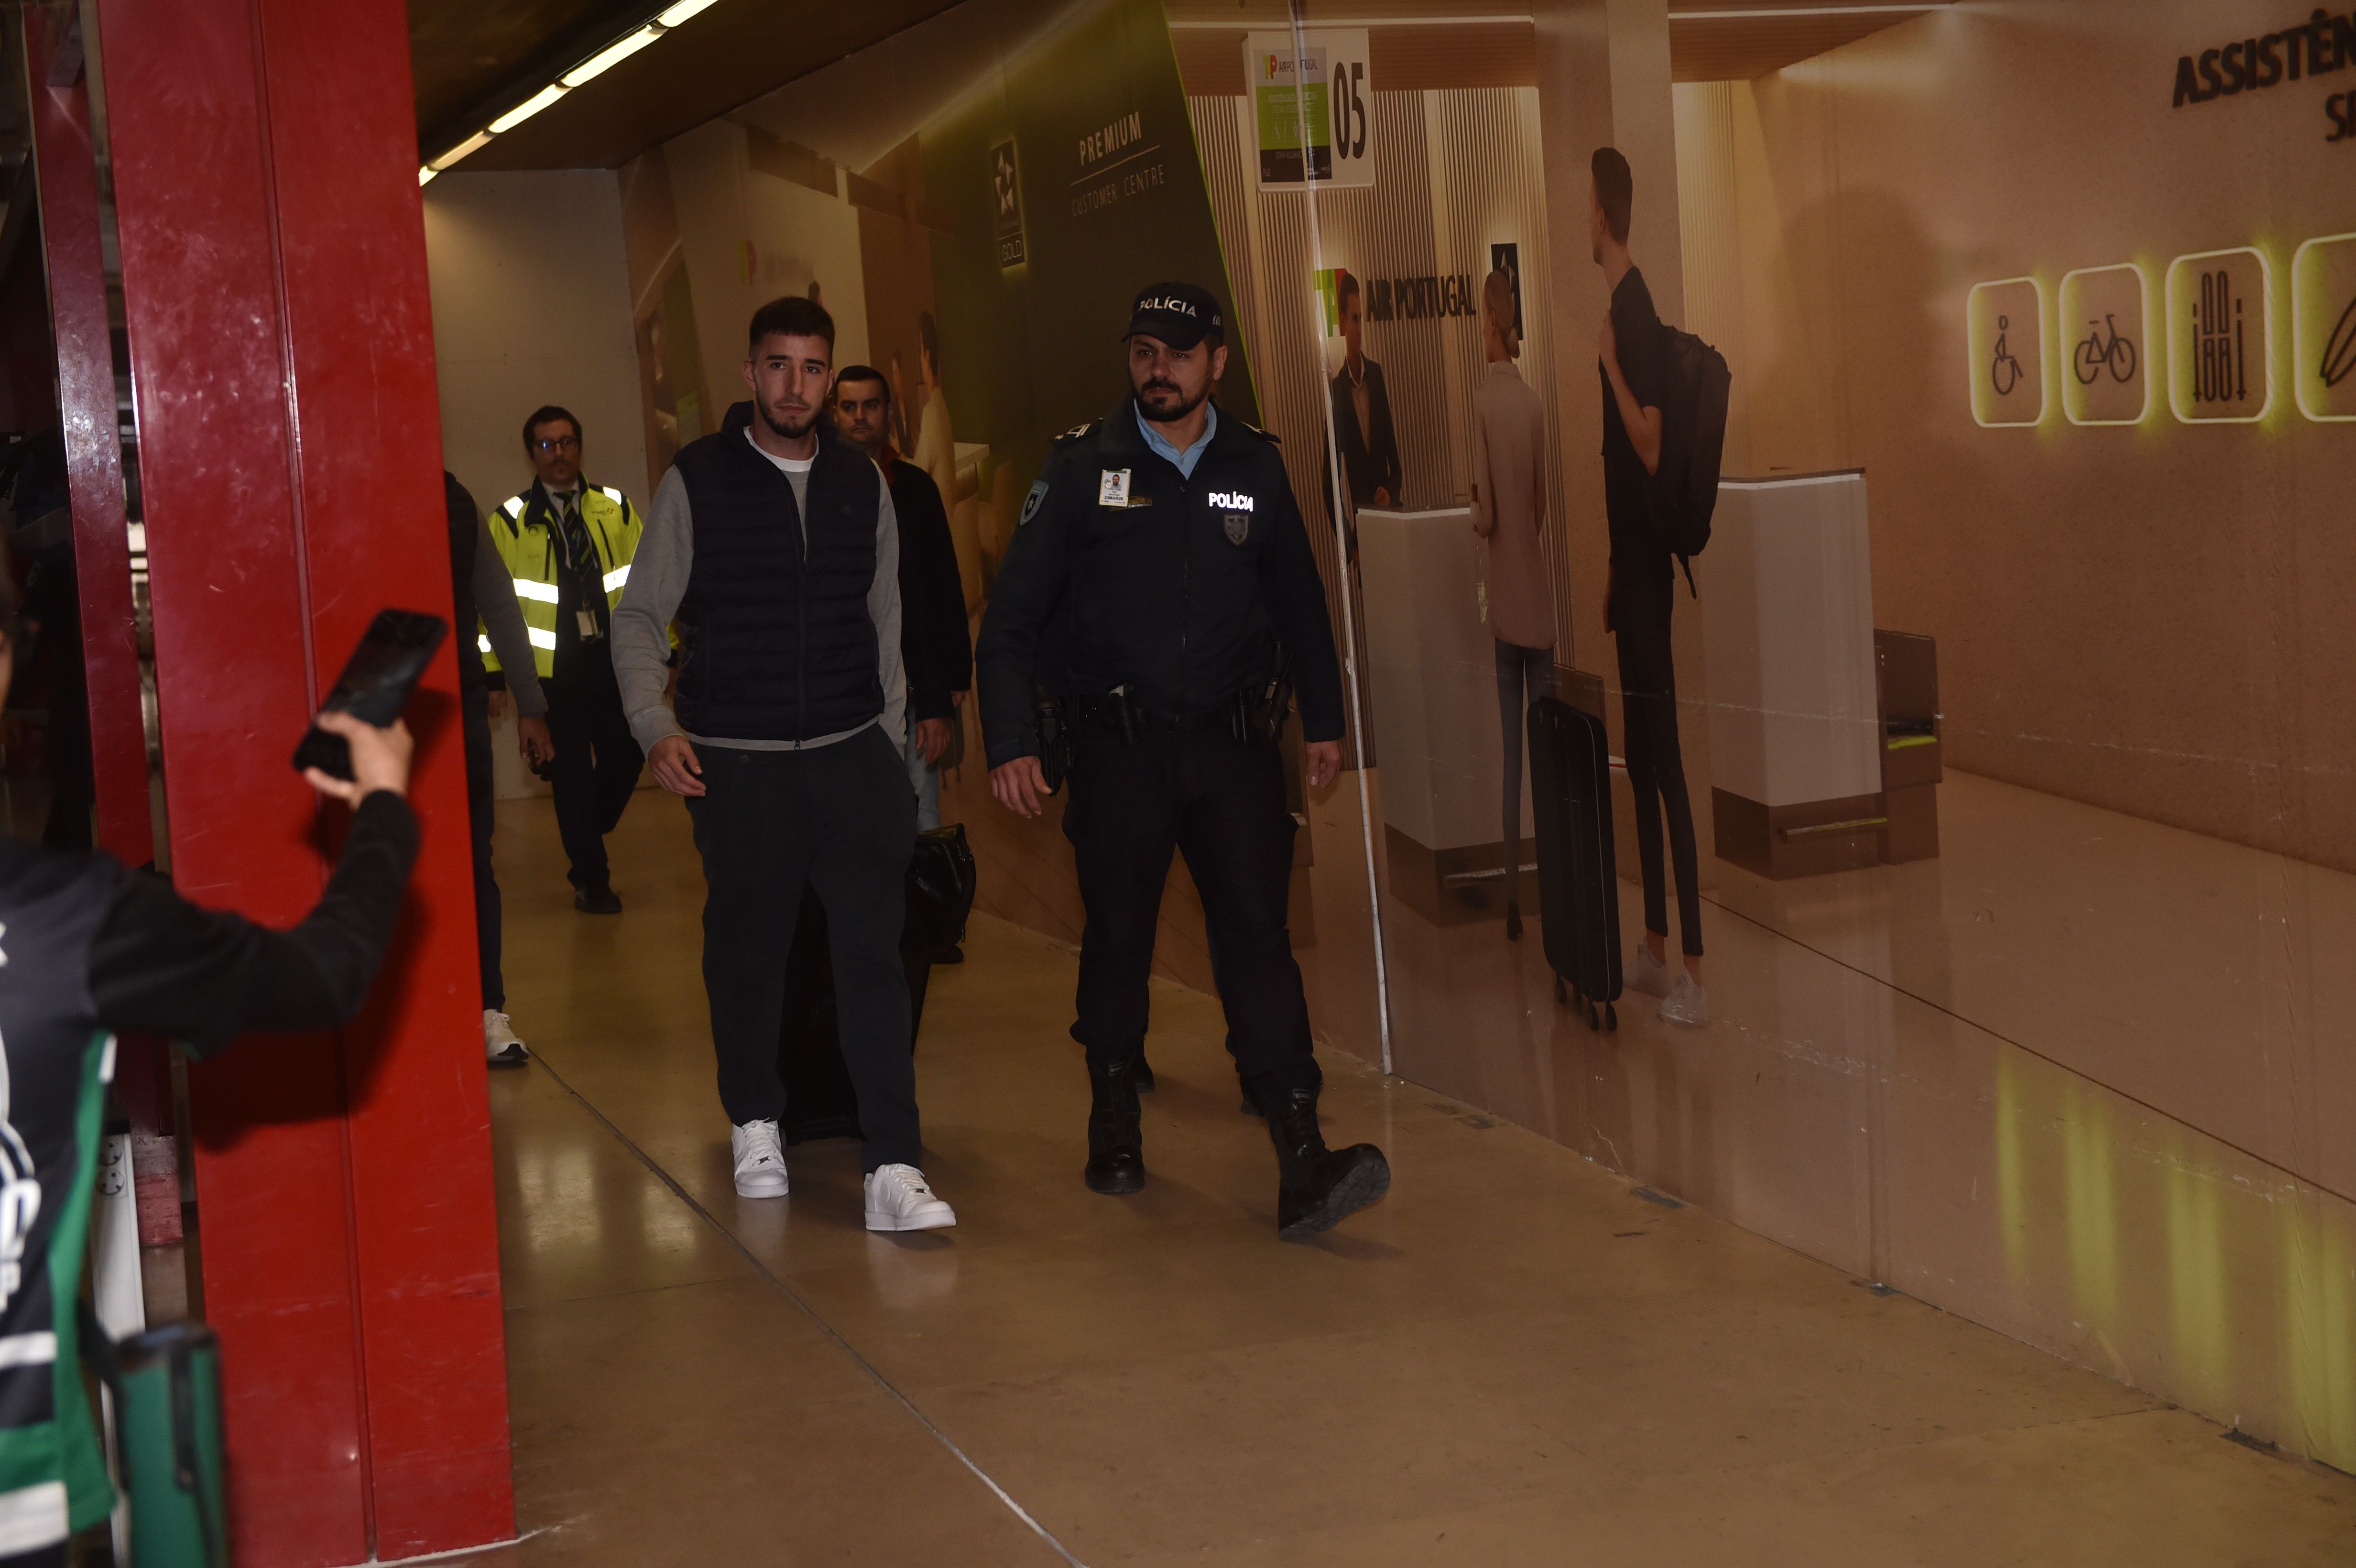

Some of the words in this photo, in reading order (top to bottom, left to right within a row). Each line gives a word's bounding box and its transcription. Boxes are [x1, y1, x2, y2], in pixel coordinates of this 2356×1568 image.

[1334, 61, 1366, 159] 05
[1080, 111, 1142, 166] PREMIUM
[1071, 183, 1118, 217] CUSTOMER
[1124, 164, 1165, 196] CENTRE
[1002, 240, 1022, 261] GOLD
[1138, 295, 1197, 318] POLÍCIA
[1209, 490, 1253, 512] POLÍCIA
